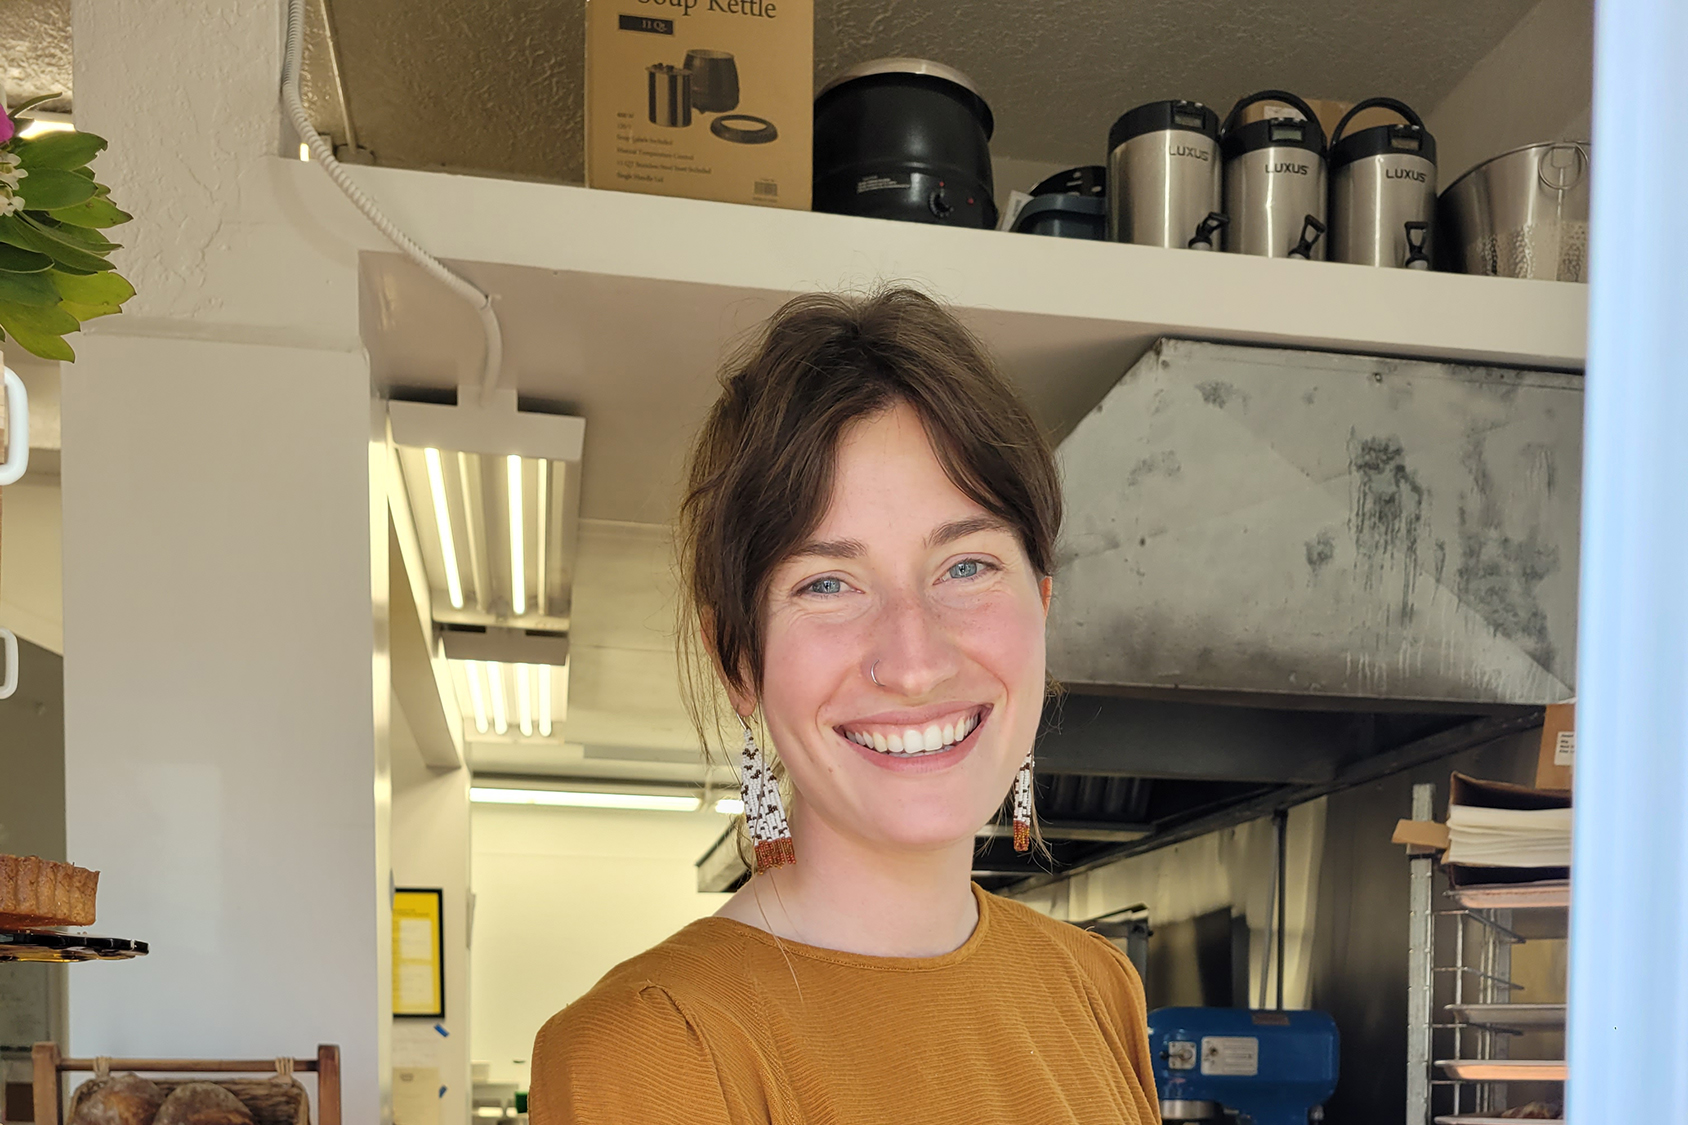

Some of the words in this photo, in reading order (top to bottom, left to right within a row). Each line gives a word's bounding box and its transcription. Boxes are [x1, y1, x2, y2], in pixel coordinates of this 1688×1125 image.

[638, 0, 697, 16] up
[707, 0, 776, 18] Kettle
[1169, 145, 1209, 162] LUXUS
[1265, 163, 1309, 176] LUXUS
[1386, 167, 1427, 183] LUXUS
